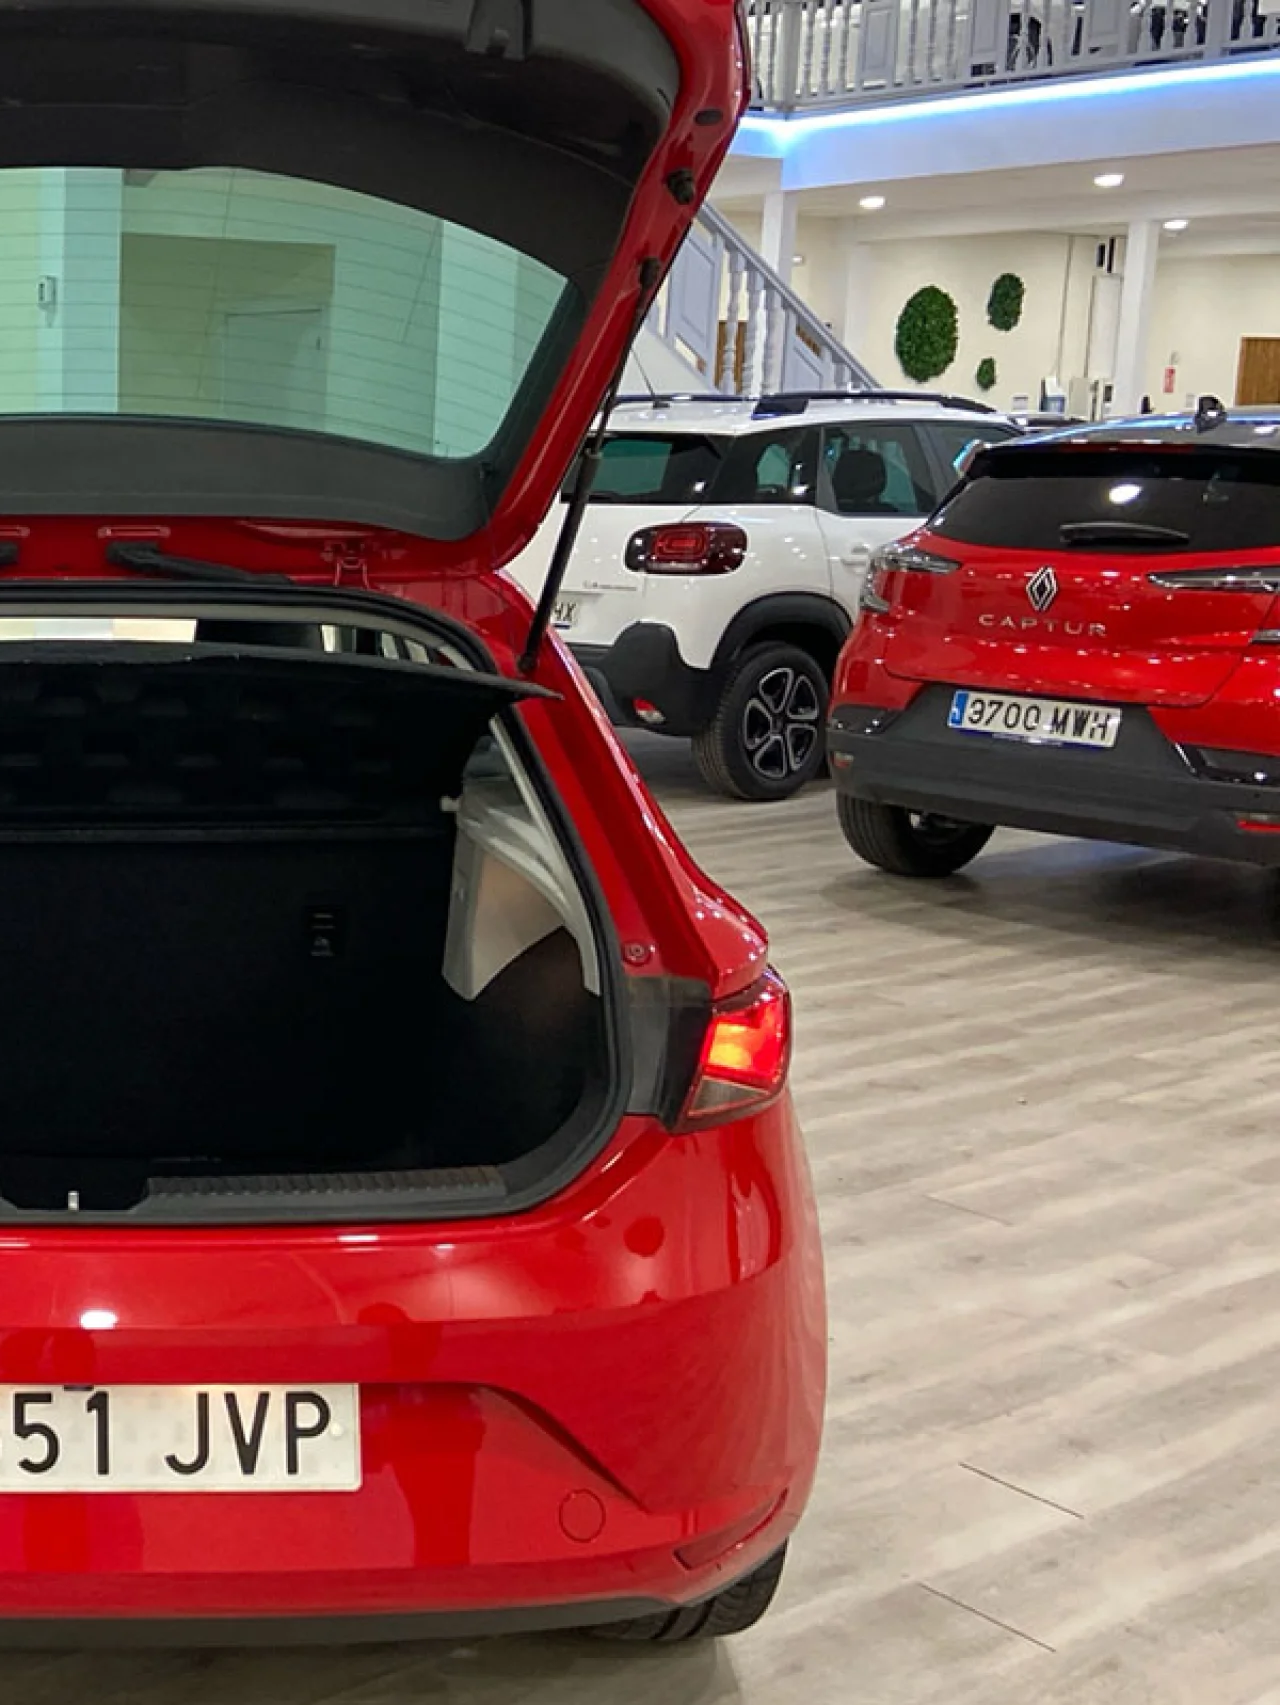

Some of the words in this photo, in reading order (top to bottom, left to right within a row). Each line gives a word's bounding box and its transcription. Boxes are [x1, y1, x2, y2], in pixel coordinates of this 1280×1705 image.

[978, 613, 1107, 637] CAPTUR
[967, 697, 1042, 732] 3700
[164, 1390, 332, 1476] JVP
